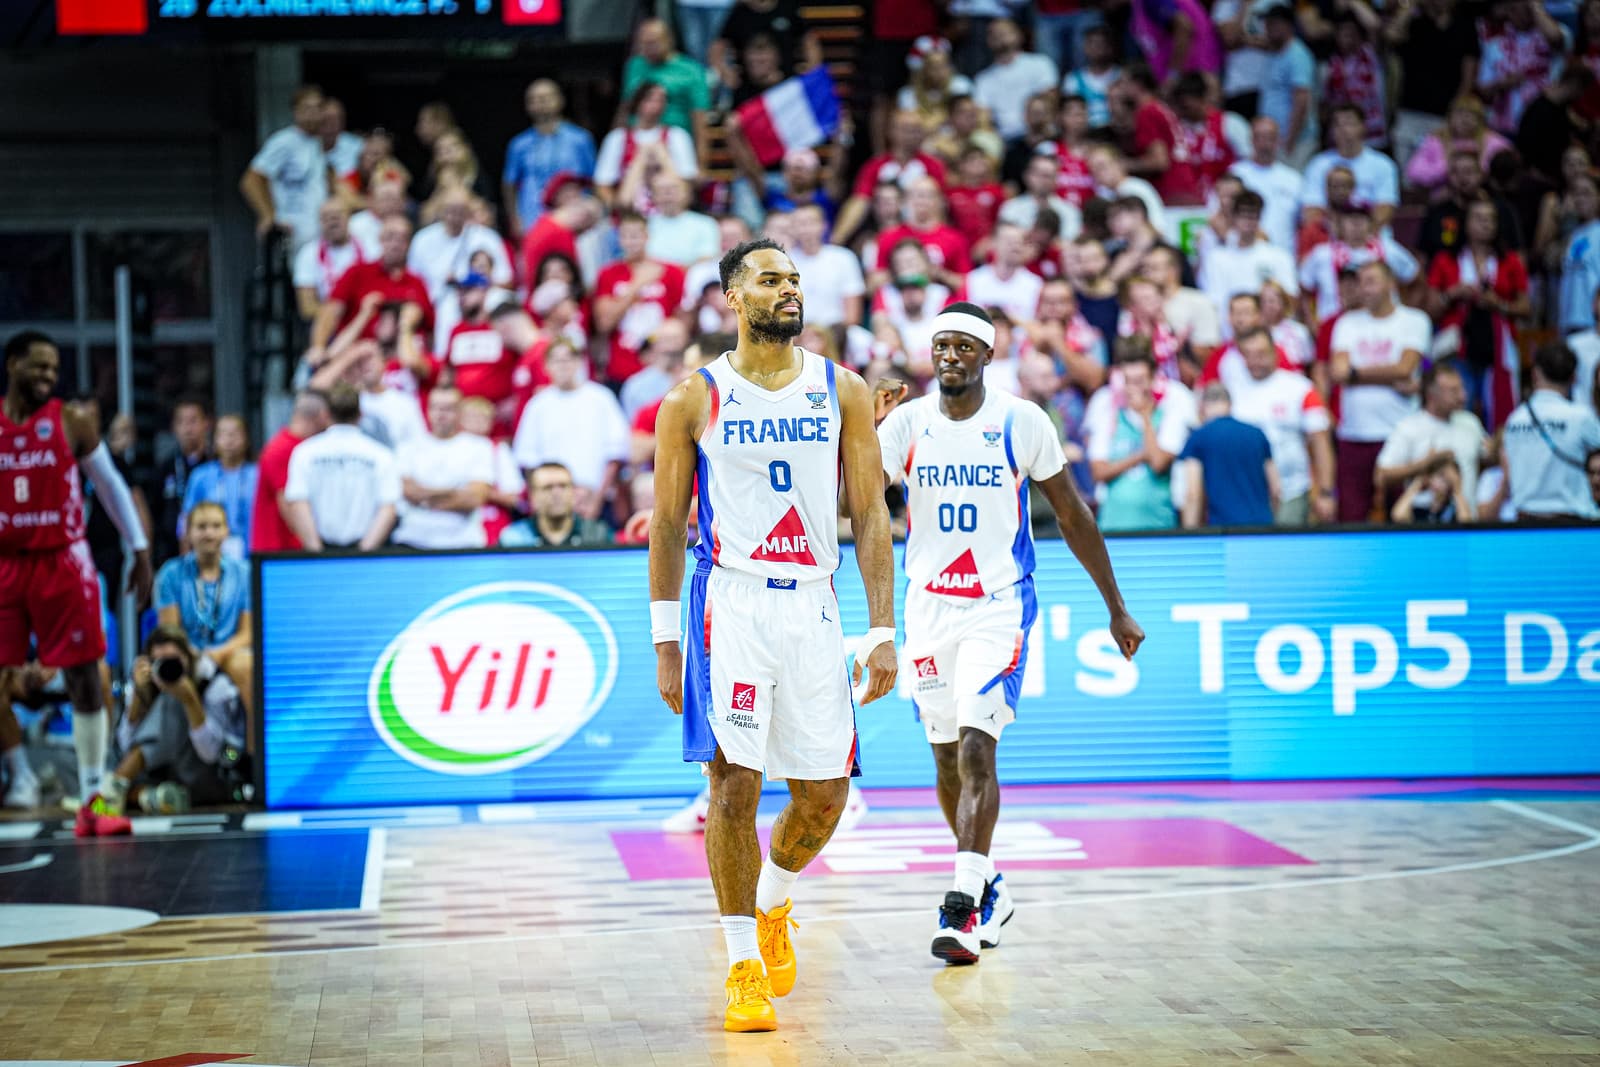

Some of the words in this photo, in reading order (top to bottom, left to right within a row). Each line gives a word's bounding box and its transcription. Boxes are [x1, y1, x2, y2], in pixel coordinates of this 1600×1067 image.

[723, 417, 829, 445] FRANCE
[0, 449, 57, 471] OLSKA
[768, 460, 793, 493] 0
[917, 464, 1004, 488] FRANCE
[938, 503, 978, 533] 00
[761, 535, 808, 555] MAIF
[931, 572, 980, 589] MAIF
[1170, 599, 1472, 716] Top5
[429, 642, 557, 713] Yili
